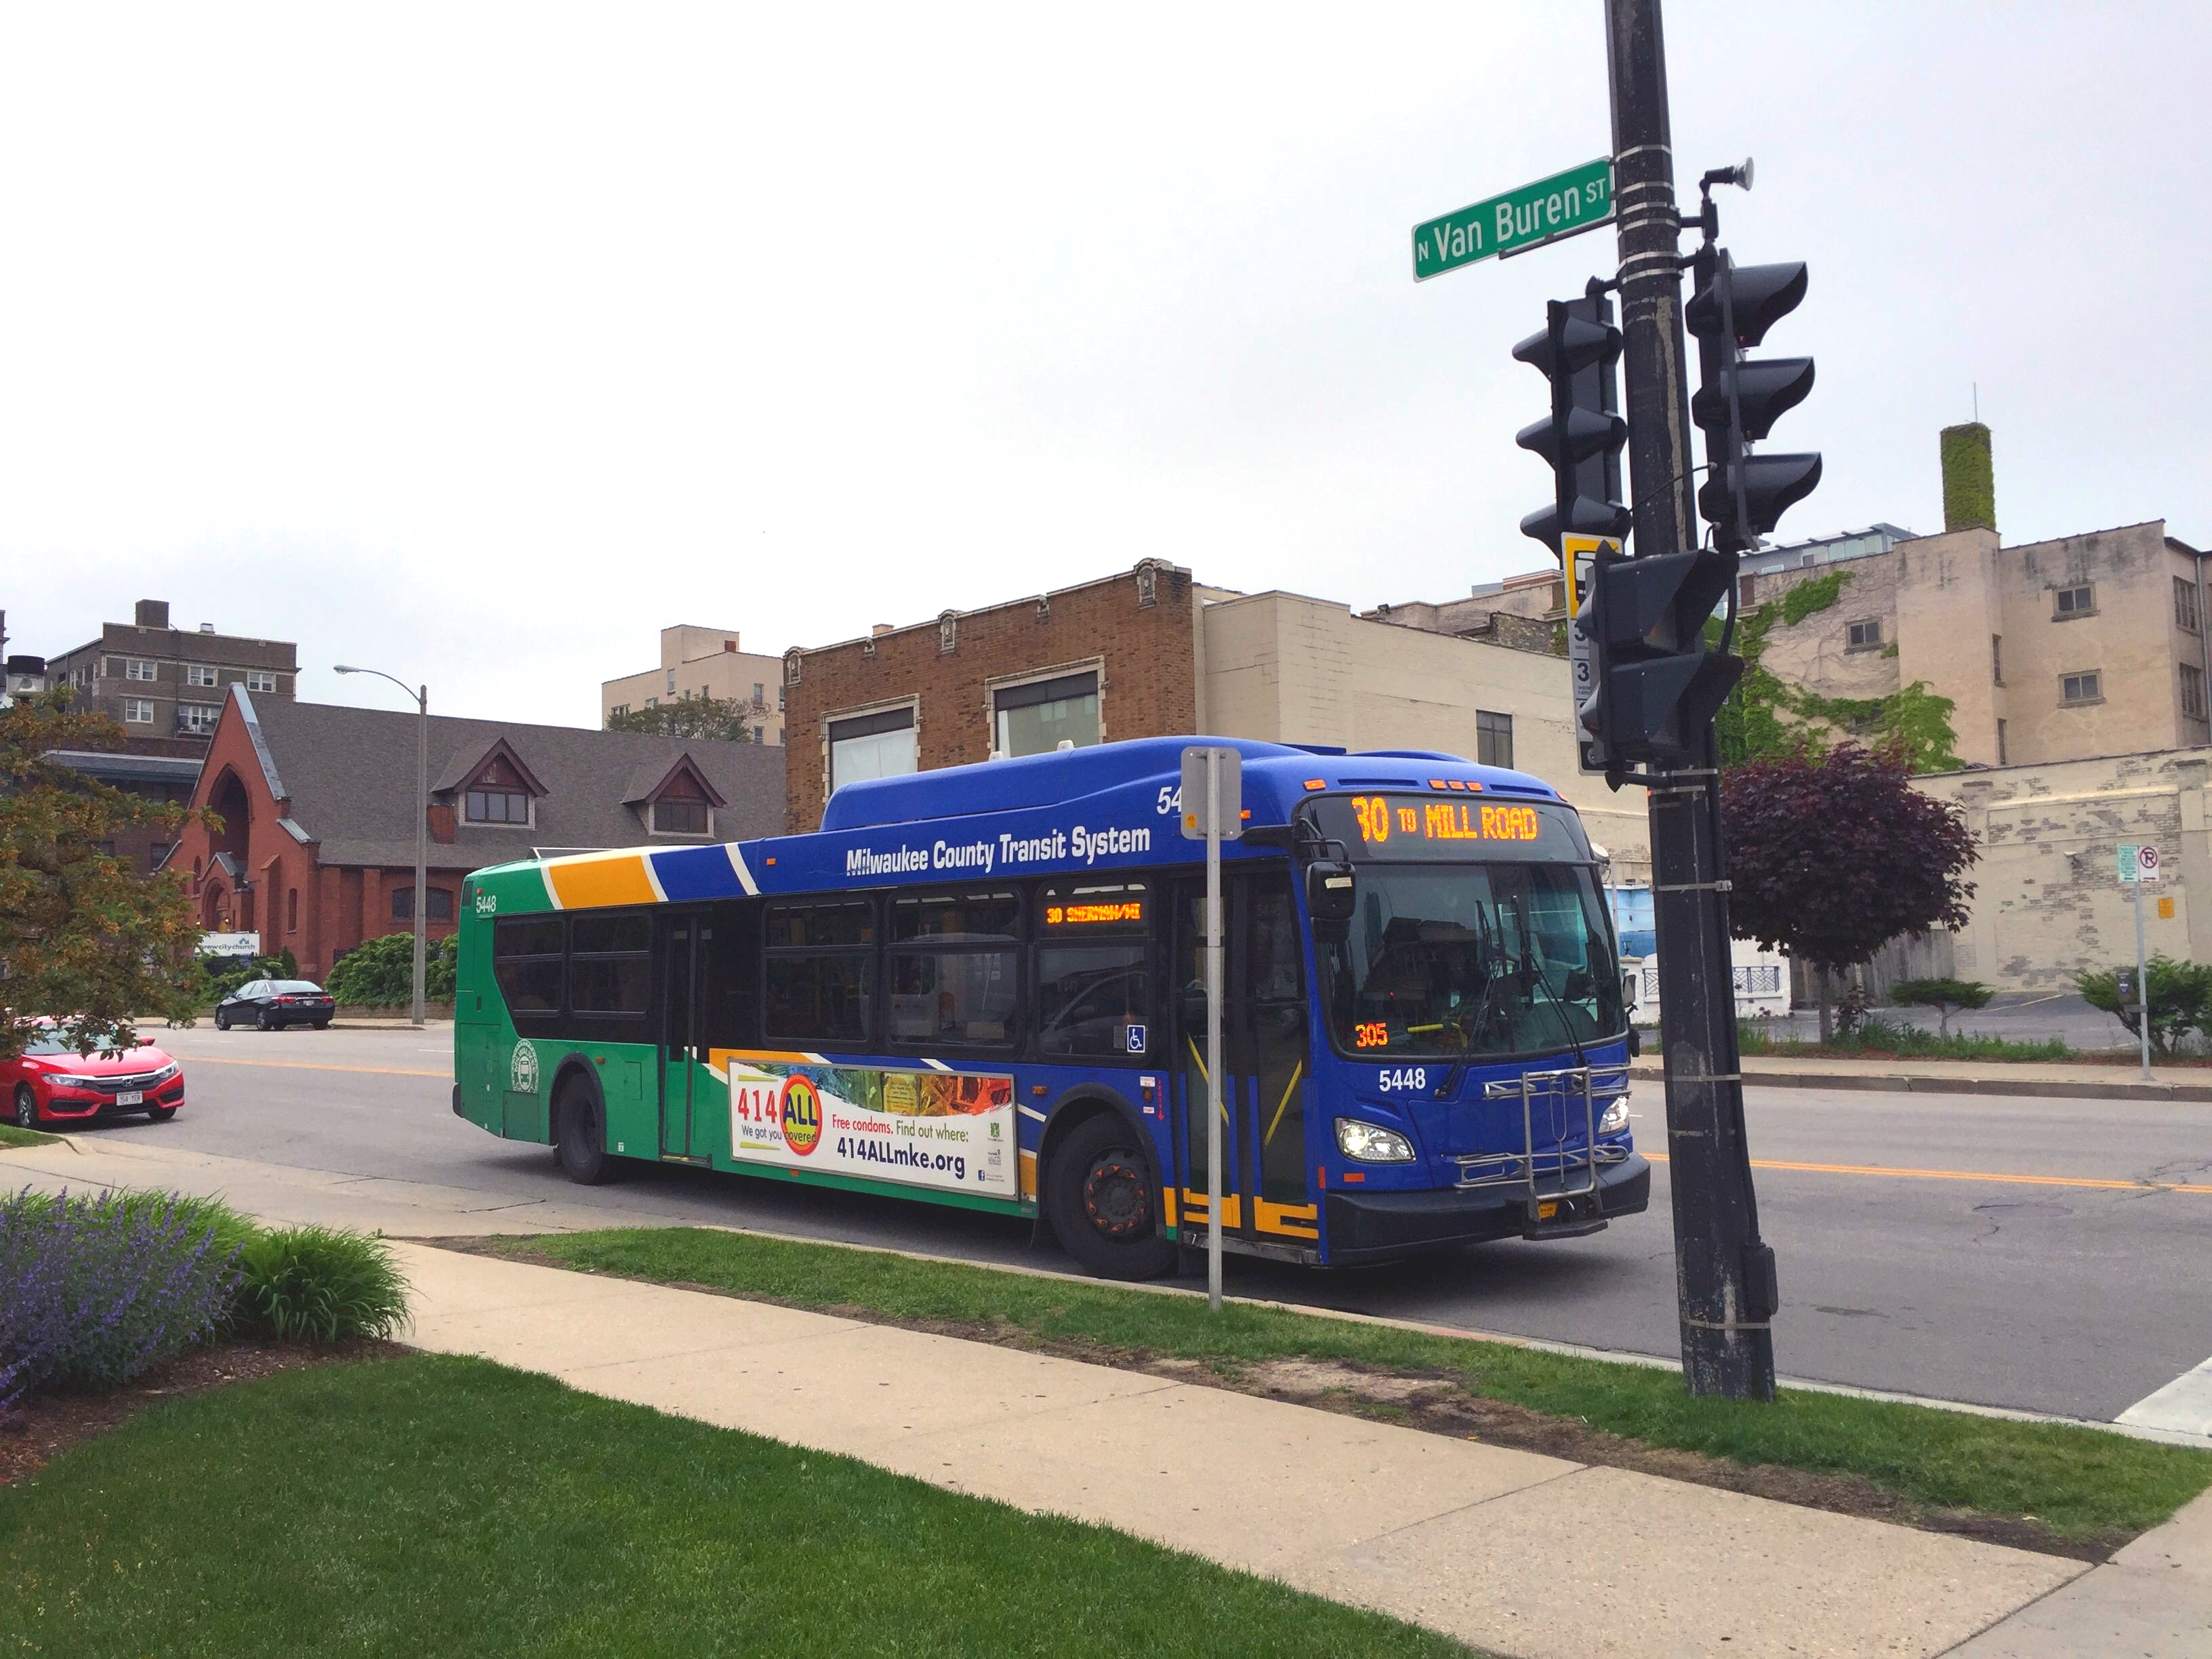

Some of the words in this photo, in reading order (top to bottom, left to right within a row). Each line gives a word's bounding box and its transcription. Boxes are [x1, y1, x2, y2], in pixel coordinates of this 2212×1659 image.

[1418, 241, 1429, 262] N
[1433, 220, 1483, 262] Van
[1495, 186, 1581, 243] Buren
[1586, 178, 1606, 203] ST
[1351, 796, 1390, 843] 30
[1397, 807, 1418, 833] TO
[1425, 803, 1478, 840] MILL
[1481, 806, 1538, 841] ROAD
[846, 844, 928, 876] Milwaukee
[933, 840, 995, 873] County
[999, 829, 1067, 863] Transit
[1071, 825, 1150, 865] System
[476, 895, 497, 914] 5448
[1046, 907, 1063, 924] 30
[1355, 1022, 1389, 1048] 305
[1379, 1067, 1426, 1092] 5448
[737, 1088, 777, 1124] 414
[783, 1092, 819, 1126] ALL
[741, 1124, 753, 1136] We
[754, 1128, 767, 1140] got
[769, 1130, 782, 1141] you
[785, 1131, 817, 1143] covered
[832, 1114, 851, 1130] Free
[853, 1116, 894, 1134] condoms.
[896, 1120, 916, 1137] Find
[918, 1125, 933, 1139] out
[935, 1123, 969, 1143] where:
[837, 1136, 966, 1180] 414ALLmke.org
